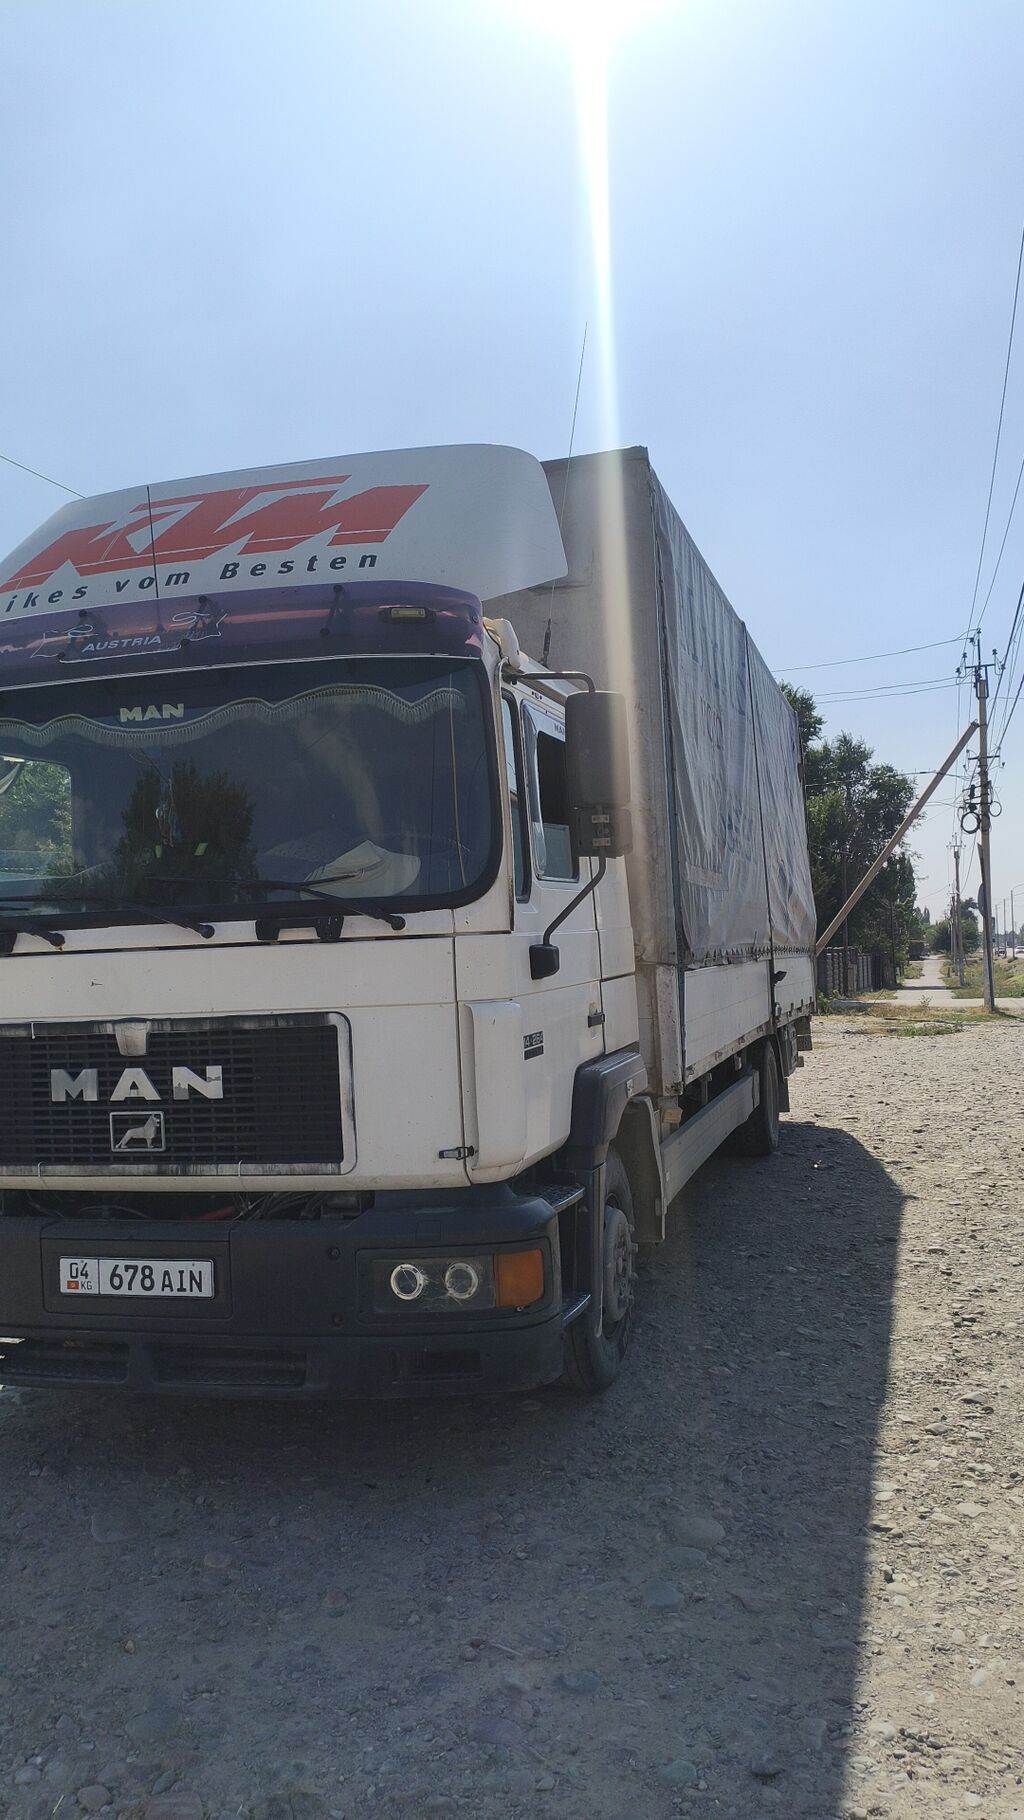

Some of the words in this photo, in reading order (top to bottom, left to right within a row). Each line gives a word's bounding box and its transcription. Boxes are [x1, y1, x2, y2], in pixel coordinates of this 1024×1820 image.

[0, 475, 430, 593] KTM
[115, 571, 190, 593] vom
[219, 554, 378, 580] Besten
[82, 635, 161, 653] AUSTRIA
[119, 703, 185, 723] MAN
[50, 1065, 223, 1102] MAN
[69, 1262, 89, 1280] 04
[109, 1264, 155, 1292] 678
[161, 1270, 203, 1293] AIN
[80, 1280, 93, 1290] KG
